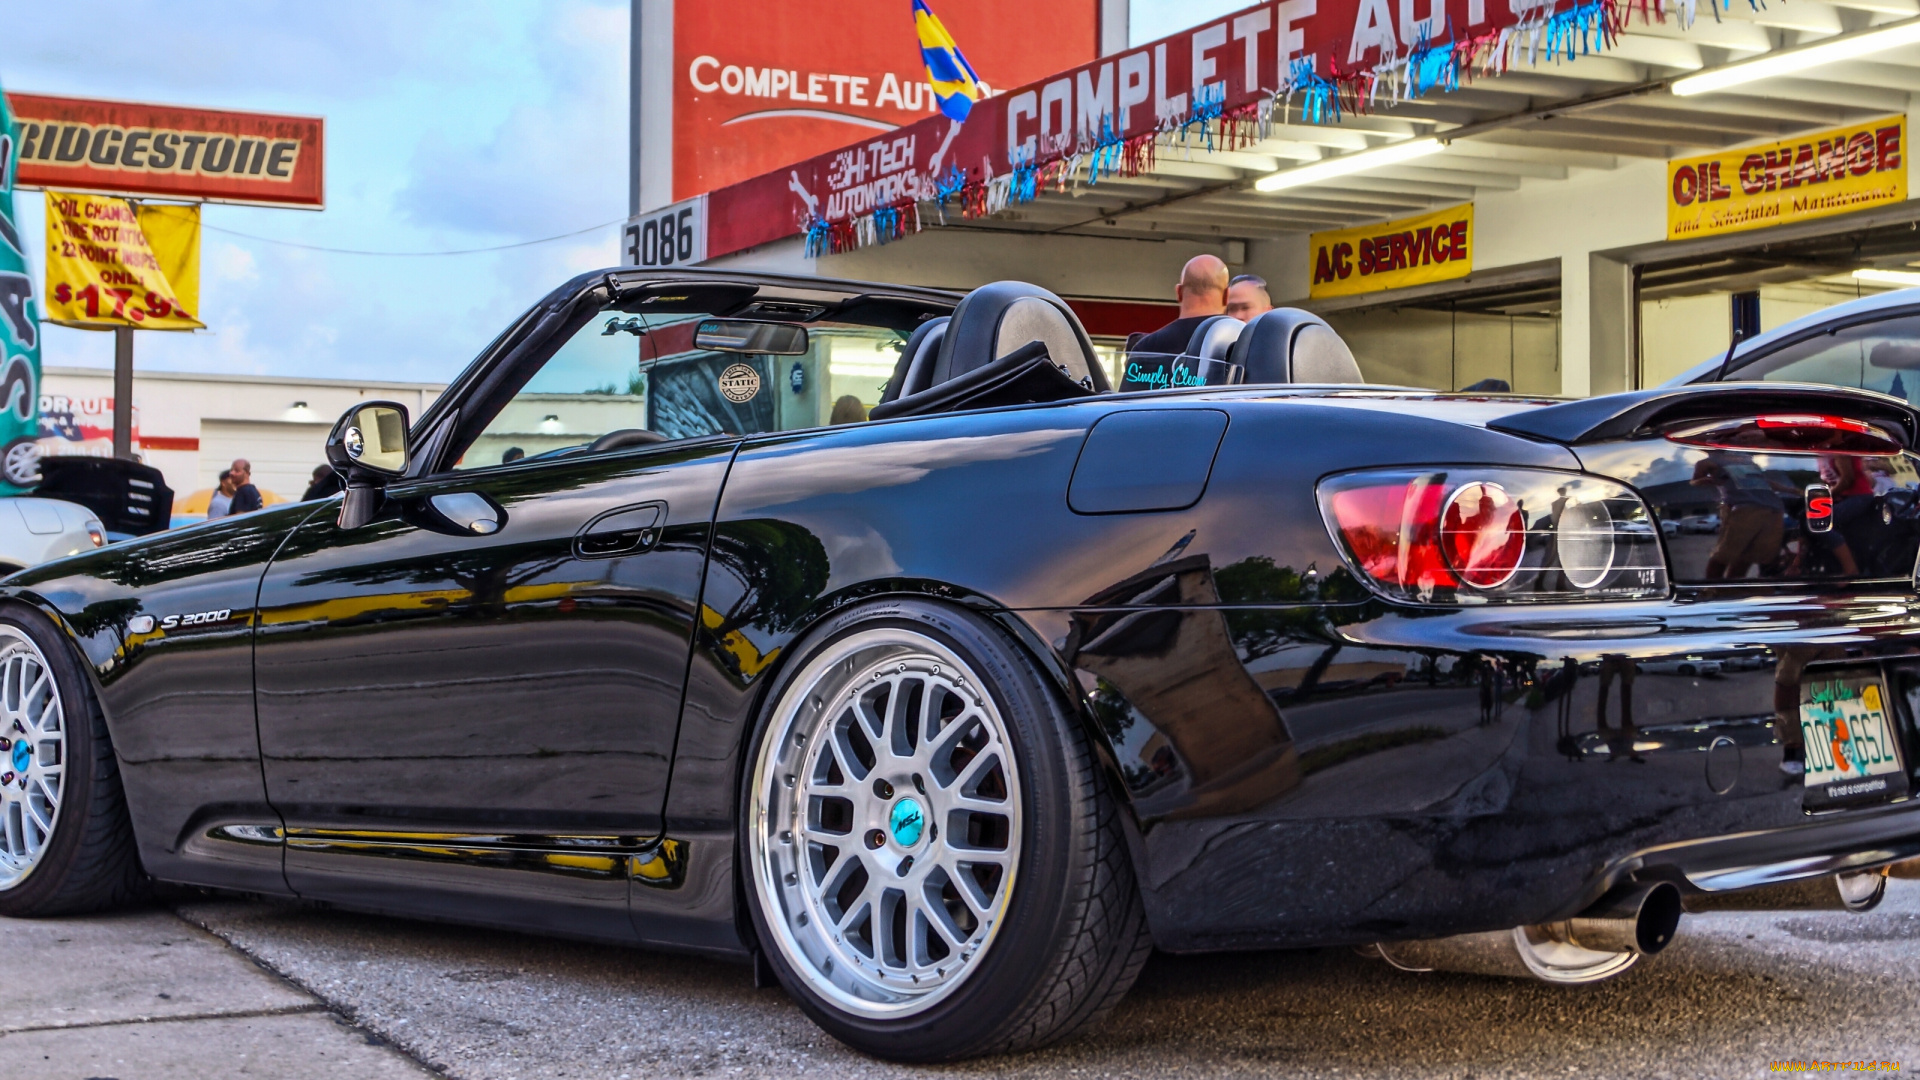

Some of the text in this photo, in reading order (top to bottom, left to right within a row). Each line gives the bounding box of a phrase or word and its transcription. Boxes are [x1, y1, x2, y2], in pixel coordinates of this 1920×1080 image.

[690, 55, 869, 106] COMPLETE
[875, 73, 937, 112] AUT
[1007, 0, 1317, 166] COMPLETE
[20, 121, 298, 178] RIDGESTONE
[842, 134, 915, 187] HI-TECH
[1673, 125, 1901, 206] OIL CHANGE
[59, 199, 80, 217] OIL
[826, 168, 918, 220] AUTOWORKS
[1675, 184, 1897, 234] and Scheduled Maintenance
[61, 220, 88, 240] TIRE
[626, 207, 693, 266] 3086
[1358, 220, 1468, 276] SERVICE
[61, 242, 161, 271] 22 POINT INSPE
[722, 379, 757, 387] STATIC
[1126, 363, 1207, 390] Simply Clean
